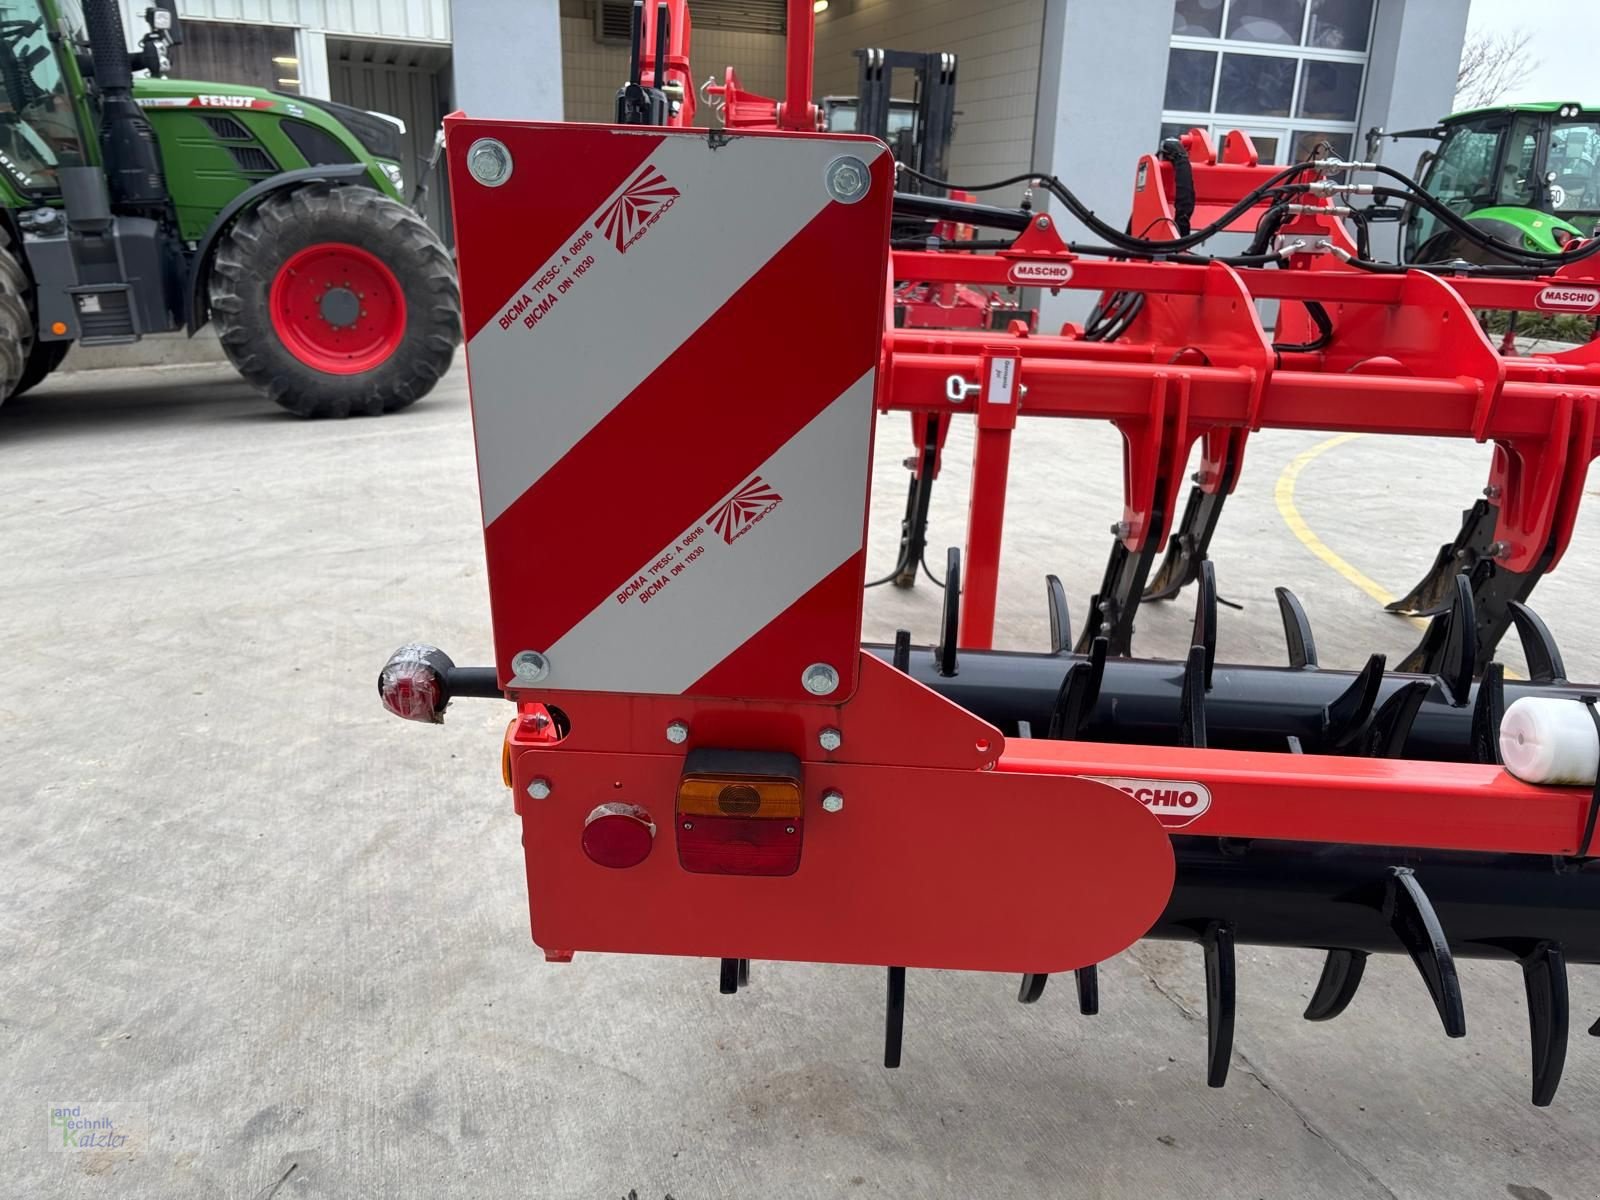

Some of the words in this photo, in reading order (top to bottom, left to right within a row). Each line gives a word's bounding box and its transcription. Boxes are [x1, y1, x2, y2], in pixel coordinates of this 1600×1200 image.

[198, 95, 256, 107] FENDT
[498, 294, 533, 330] BICMA
[569, 230, 593, 256] 06016
[1017, 266, 1068, 277] MASCHIO
[523, 293, 559, 330] BICMA
[557, 276, 575, 294] DIN
[573, 255, 595, 279] 11030
[1544, 291, 1596, 303] MASCHIO
[616, 575, 648, 604] BICMA
[682, 526, 705, 547] 06016
[638, 575, 671, 604] BICMA
[670, 562, 686, 577] DIN
[684, 545, 705, 564] 11030
[1119, 787, 1199, 808] CHIO
